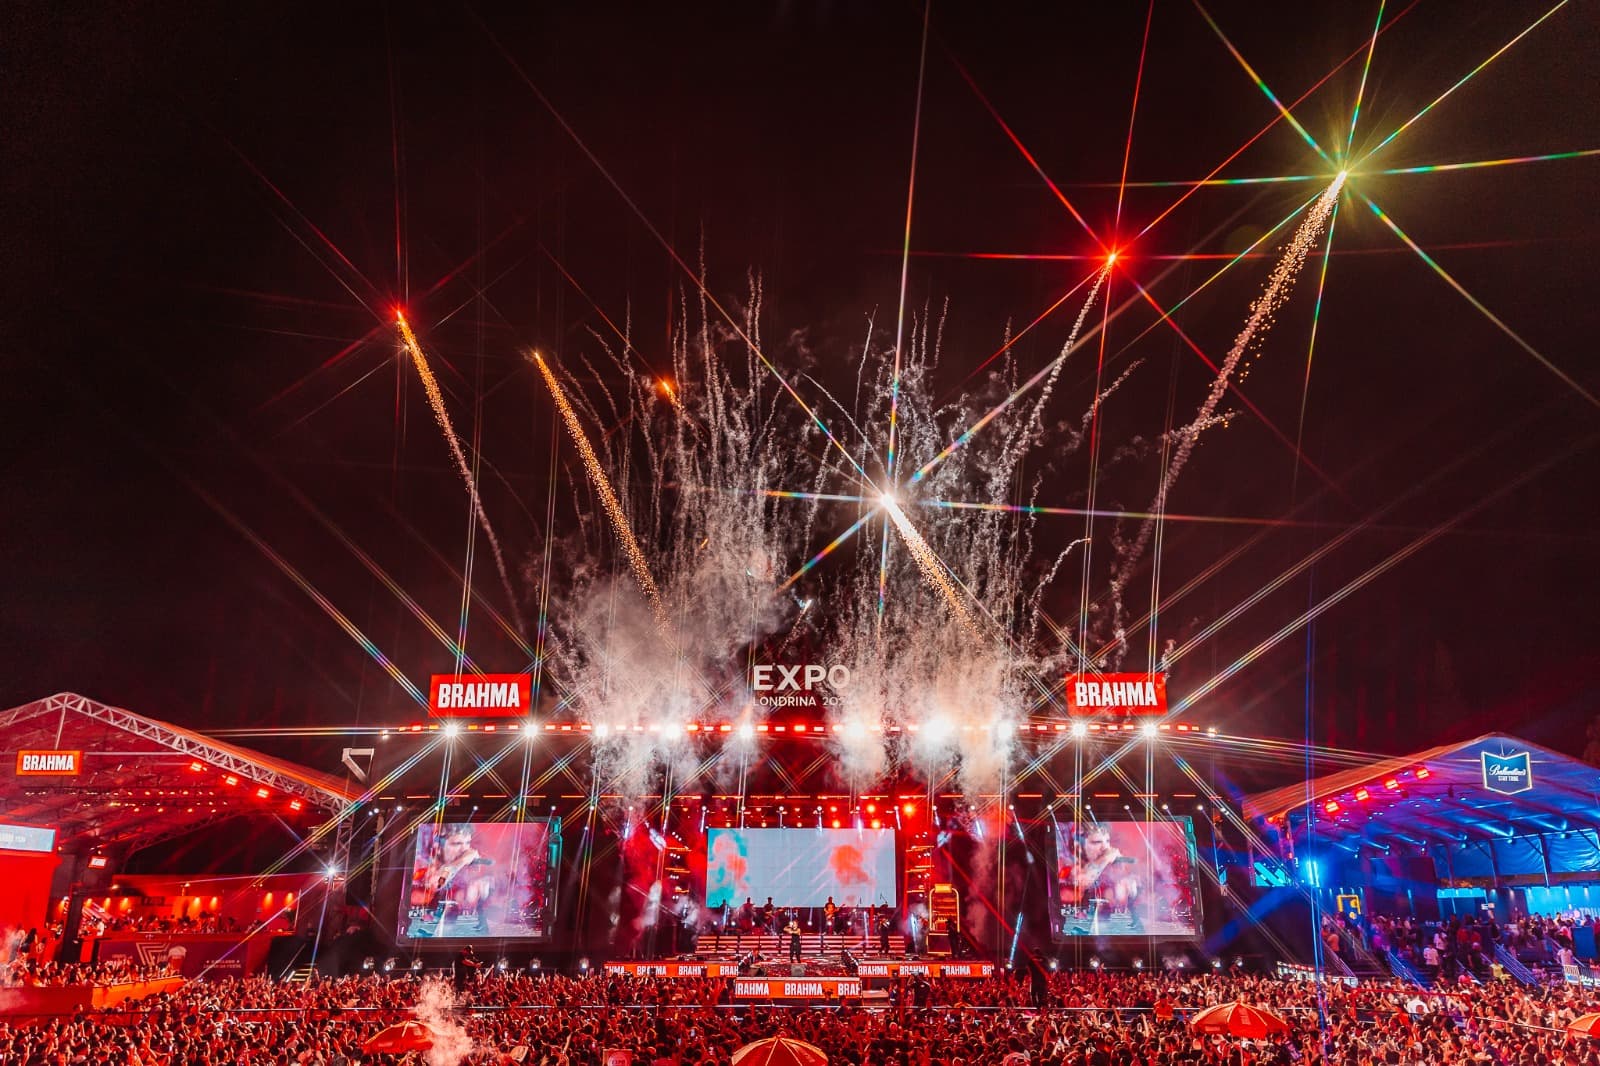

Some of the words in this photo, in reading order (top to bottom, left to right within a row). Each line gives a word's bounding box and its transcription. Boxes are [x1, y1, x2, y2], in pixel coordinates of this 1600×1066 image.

[753, 664, 851, 691] EXPO
[437, 682, 520, 708] BRAHMA
[753, 696, 817, 707] LONDRINA
[1075, 681, 1158, 707] BRAHMA
[22, 754, 75, 771] BRAHMA
[637, 965, 667, 976] BRAMA
[858, 965, 888, 976] BRAHMA
[784, 983, 824, 996] BRAHMA
